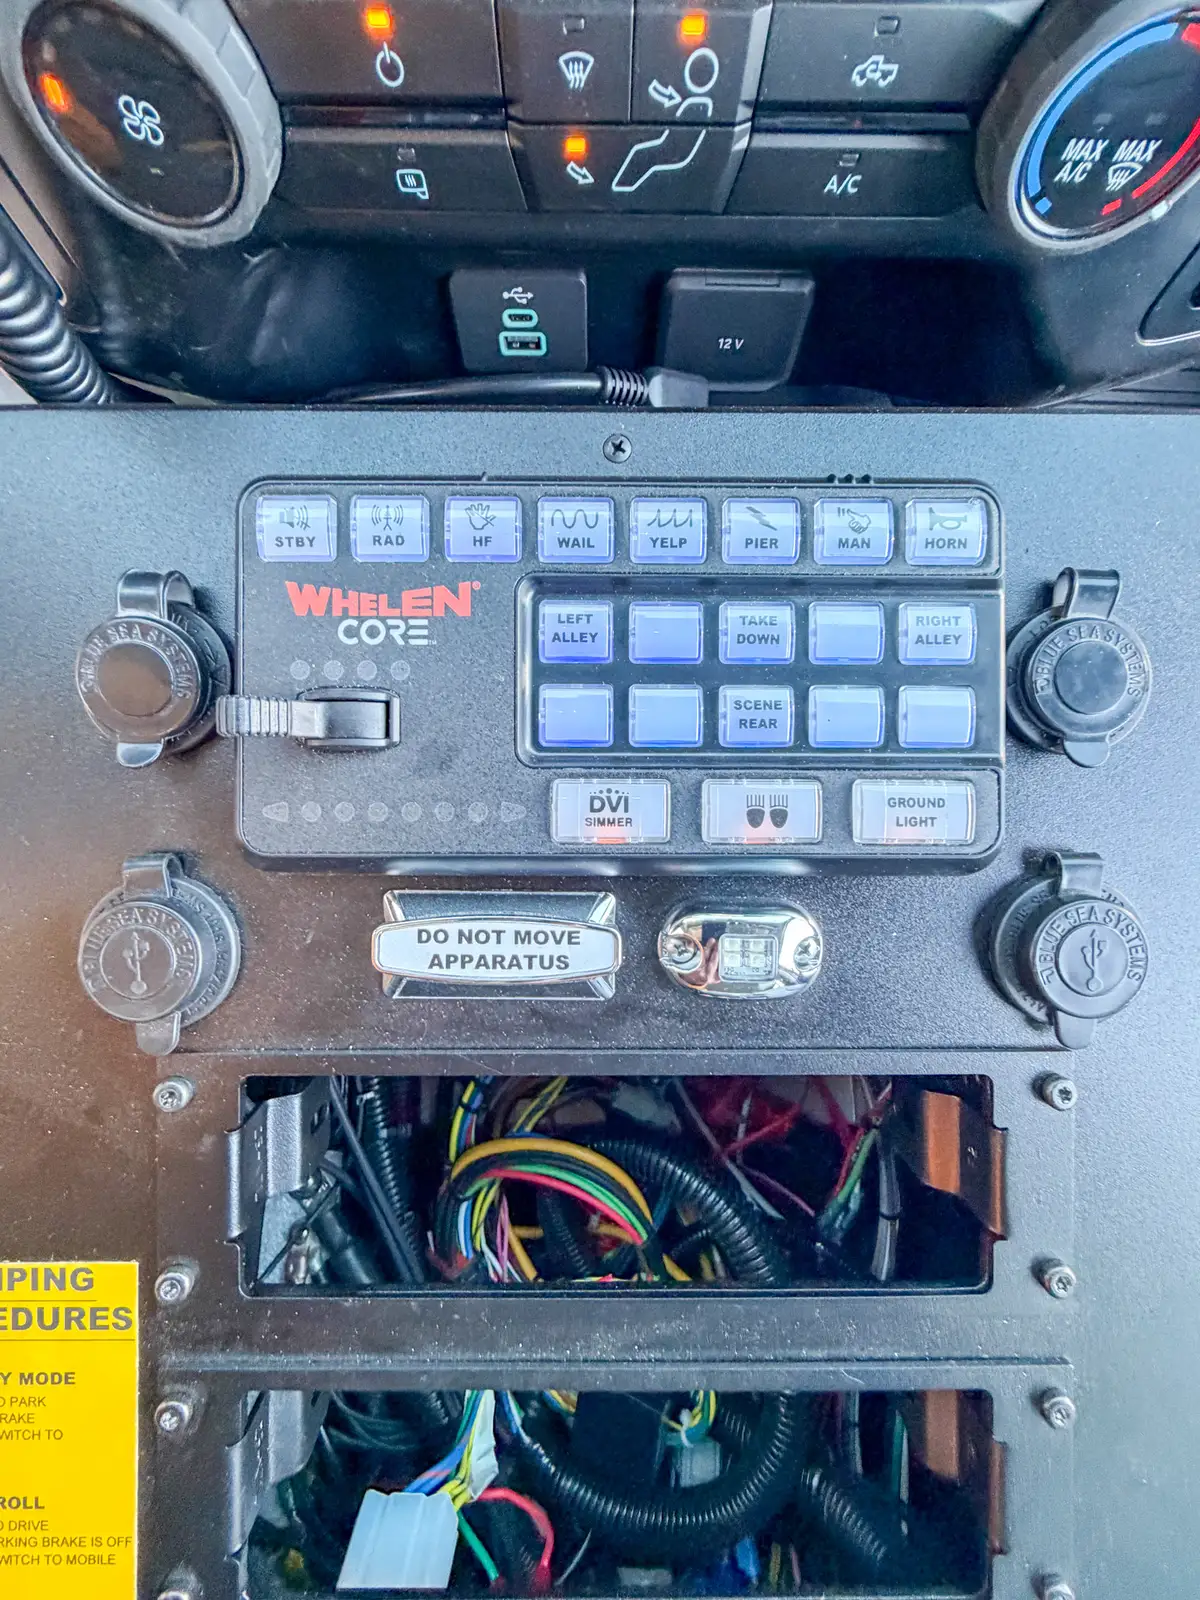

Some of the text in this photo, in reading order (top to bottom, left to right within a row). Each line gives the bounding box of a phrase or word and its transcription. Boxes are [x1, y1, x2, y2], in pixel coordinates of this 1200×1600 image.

[1060, 138, 1162, 163] MAX MAX
[1053, 160, 1093, 184] A/C
[824, 173, 862, 195] A/C
[718, 337, 745, 350] 12 V
[274, 536, 316, 548] STBY
[372, 534, 406, 547] RAD
[472, 535, 493, 547] HF
[557, 536, 596, 549] WAIL
[649, 536, 688, 549] YELP
[744, 537, 779, 549] PIER
[837, 537, 871, 549] MAN
[924, 537, 968, 550] HORN
[557, 613, 594, 625] LEFT
[739, 615, 778, 626] TAKE
[915, 615, 961, 627] RIGHT
[551, 631, 599, 643] ALLEY
[736, 633, 781, 646] DOWN
[914, 633, 963, 646] ALLEY
[1066, 625, 1101, 643] SEA
[1103, 629, 1146, 698] SYSTEMS
[733, 699, 783, 711] SCENE
[738, 717, 779, 730] REAR
[589, 796, 629, 814] DVI
[886, 797, 946, 809] GROUND
[584, 816, 633, 828] SIMMER
[895, 815, 938, 828] LIGHT
[416, 930, 582, 946] DO NOT MOVE
[1038, 919, 1066, 963] BLUE
[1064, 905, 1099, 925] SEA
[1103, 907, 1145, 982] SYSTEMS
[428, 953, 571, 971] APPARATUS
[0, 1267, 95, 1292] PING
[19, 1372, 76, 1386] MODE
[9, 1396, 47, 1408] PARK
[45, 1429, 64, 1441] TO
[8, 1520, 49, 1532] DRIVE
[42, 1536, 87, 1548] BRAKE
[91, 1536, 103, 1548] IS
[106, 1536, 133, 1548] OFF
[44, 1554, 62, 1566] TO
[66, 1554, 117, 1566] MOBILE
